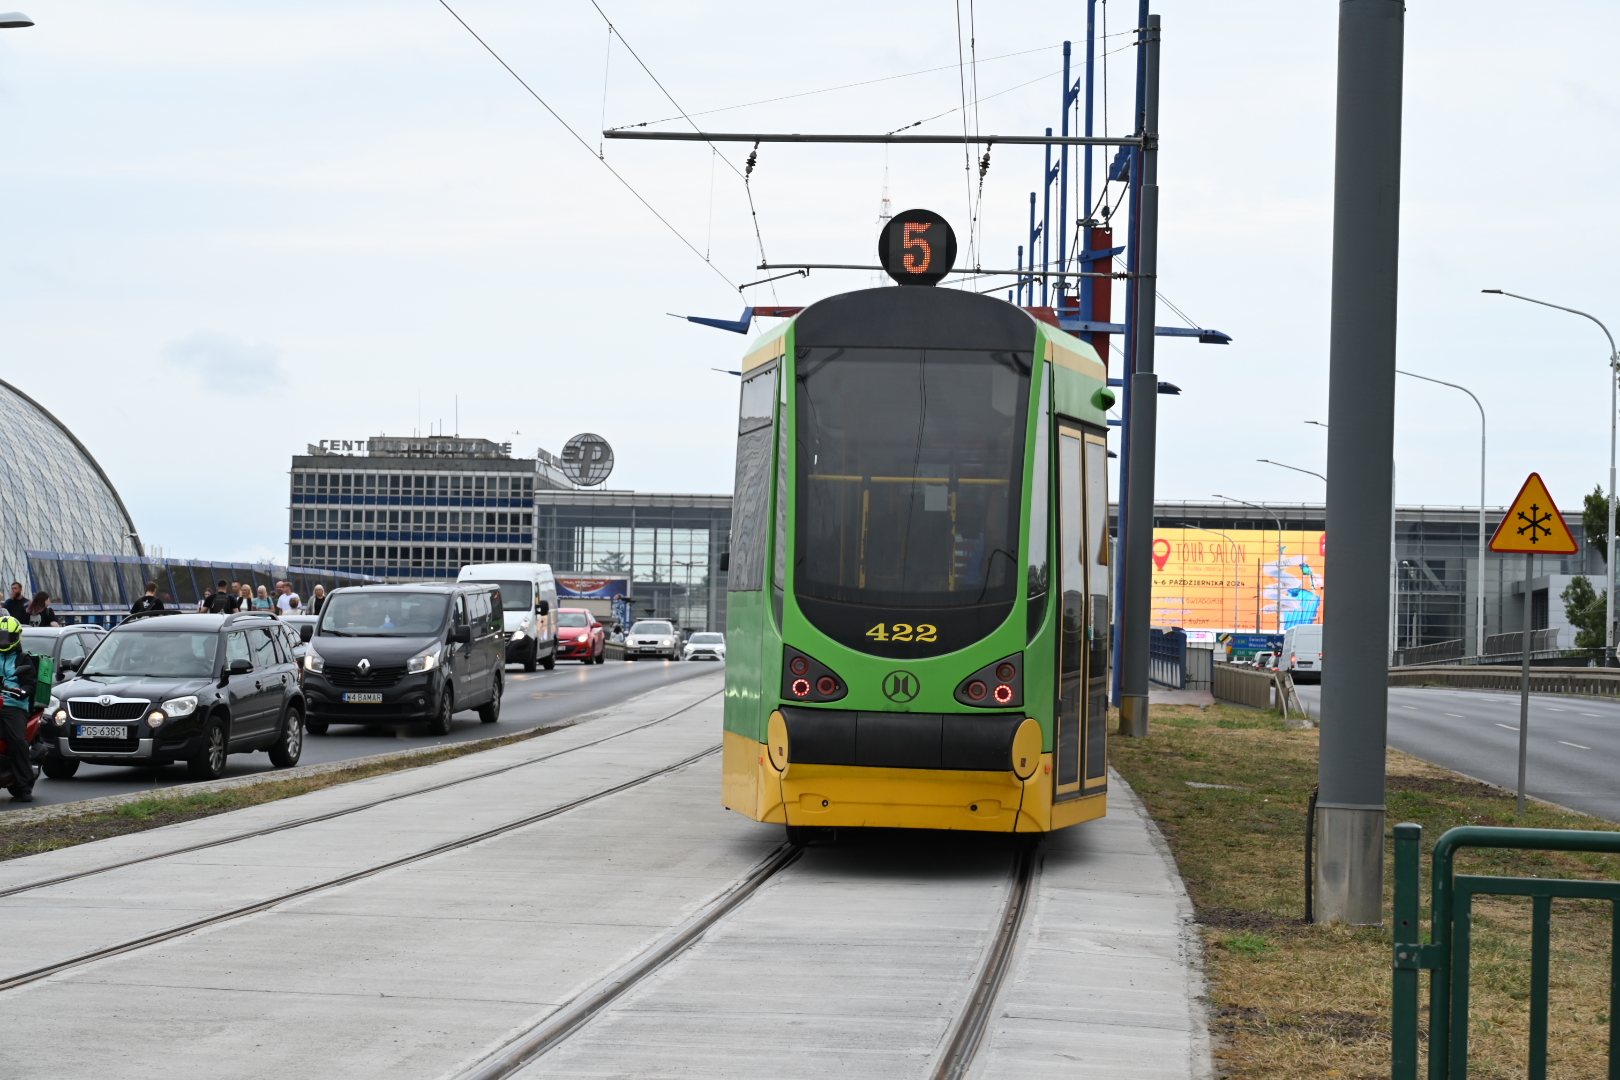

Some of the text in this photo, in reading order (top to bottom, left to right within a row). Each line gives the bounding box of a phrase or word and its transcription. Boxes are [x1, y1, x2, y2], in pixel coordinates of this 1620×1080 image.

[903, 222, 932, 273] 5
[1175, 541, 1246, 564] TOUR SALON
[1169, 577, 1224, 587] PAŹDZIERNIKA
[865, 622, 938, 643] 422
[81, 726, 126, 737] PGS 63851
